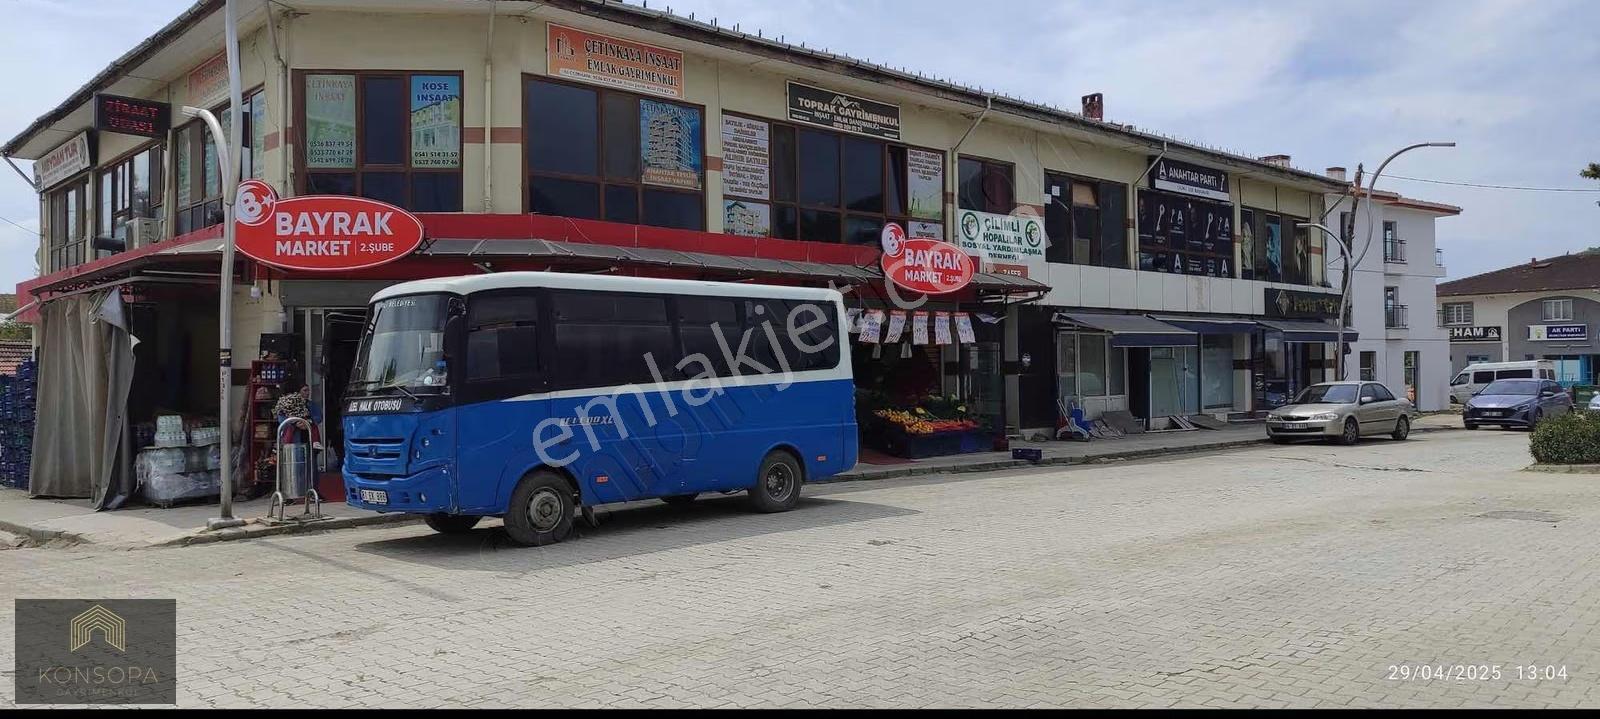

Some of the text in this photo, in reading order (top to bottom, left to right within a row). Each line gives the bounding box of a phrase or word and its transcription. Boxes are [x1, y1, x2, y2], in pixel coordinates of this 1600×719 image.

[585, 38, 642, 64] ÇETİNKAYA
[645, 49, 680, 70] İNŞAAT
[588, 59, 618, 74] EMLAK
[620, 66, 678, 87] GAYRİMENKUL
[105, 99, 158, 118] ZİRAAT
[798, 97, 900, 127] TOPRAK GAYRİMENKUL
[1168, 167, 1199, 183] ANAHTAR
[1199, 173, 1217, 187] PARTİ
[276, 211, 393, 236] BAYRAK
[984, 216, 1020, 232] ÇİLİMLİ
[276, 240, 351, 256] MARKET
[962, 241, 1042, 256] SOSYAL YARDIMLAŞMA
[983, 232, 1023, 246] HOPALILAR
[904, 248, 962, 270] BAYRAK
[904, 270, 943, 284] MARKET
[358, 400, 372, 411] HALK
[373, 398, 402, 411] OTOBÜSÜ
